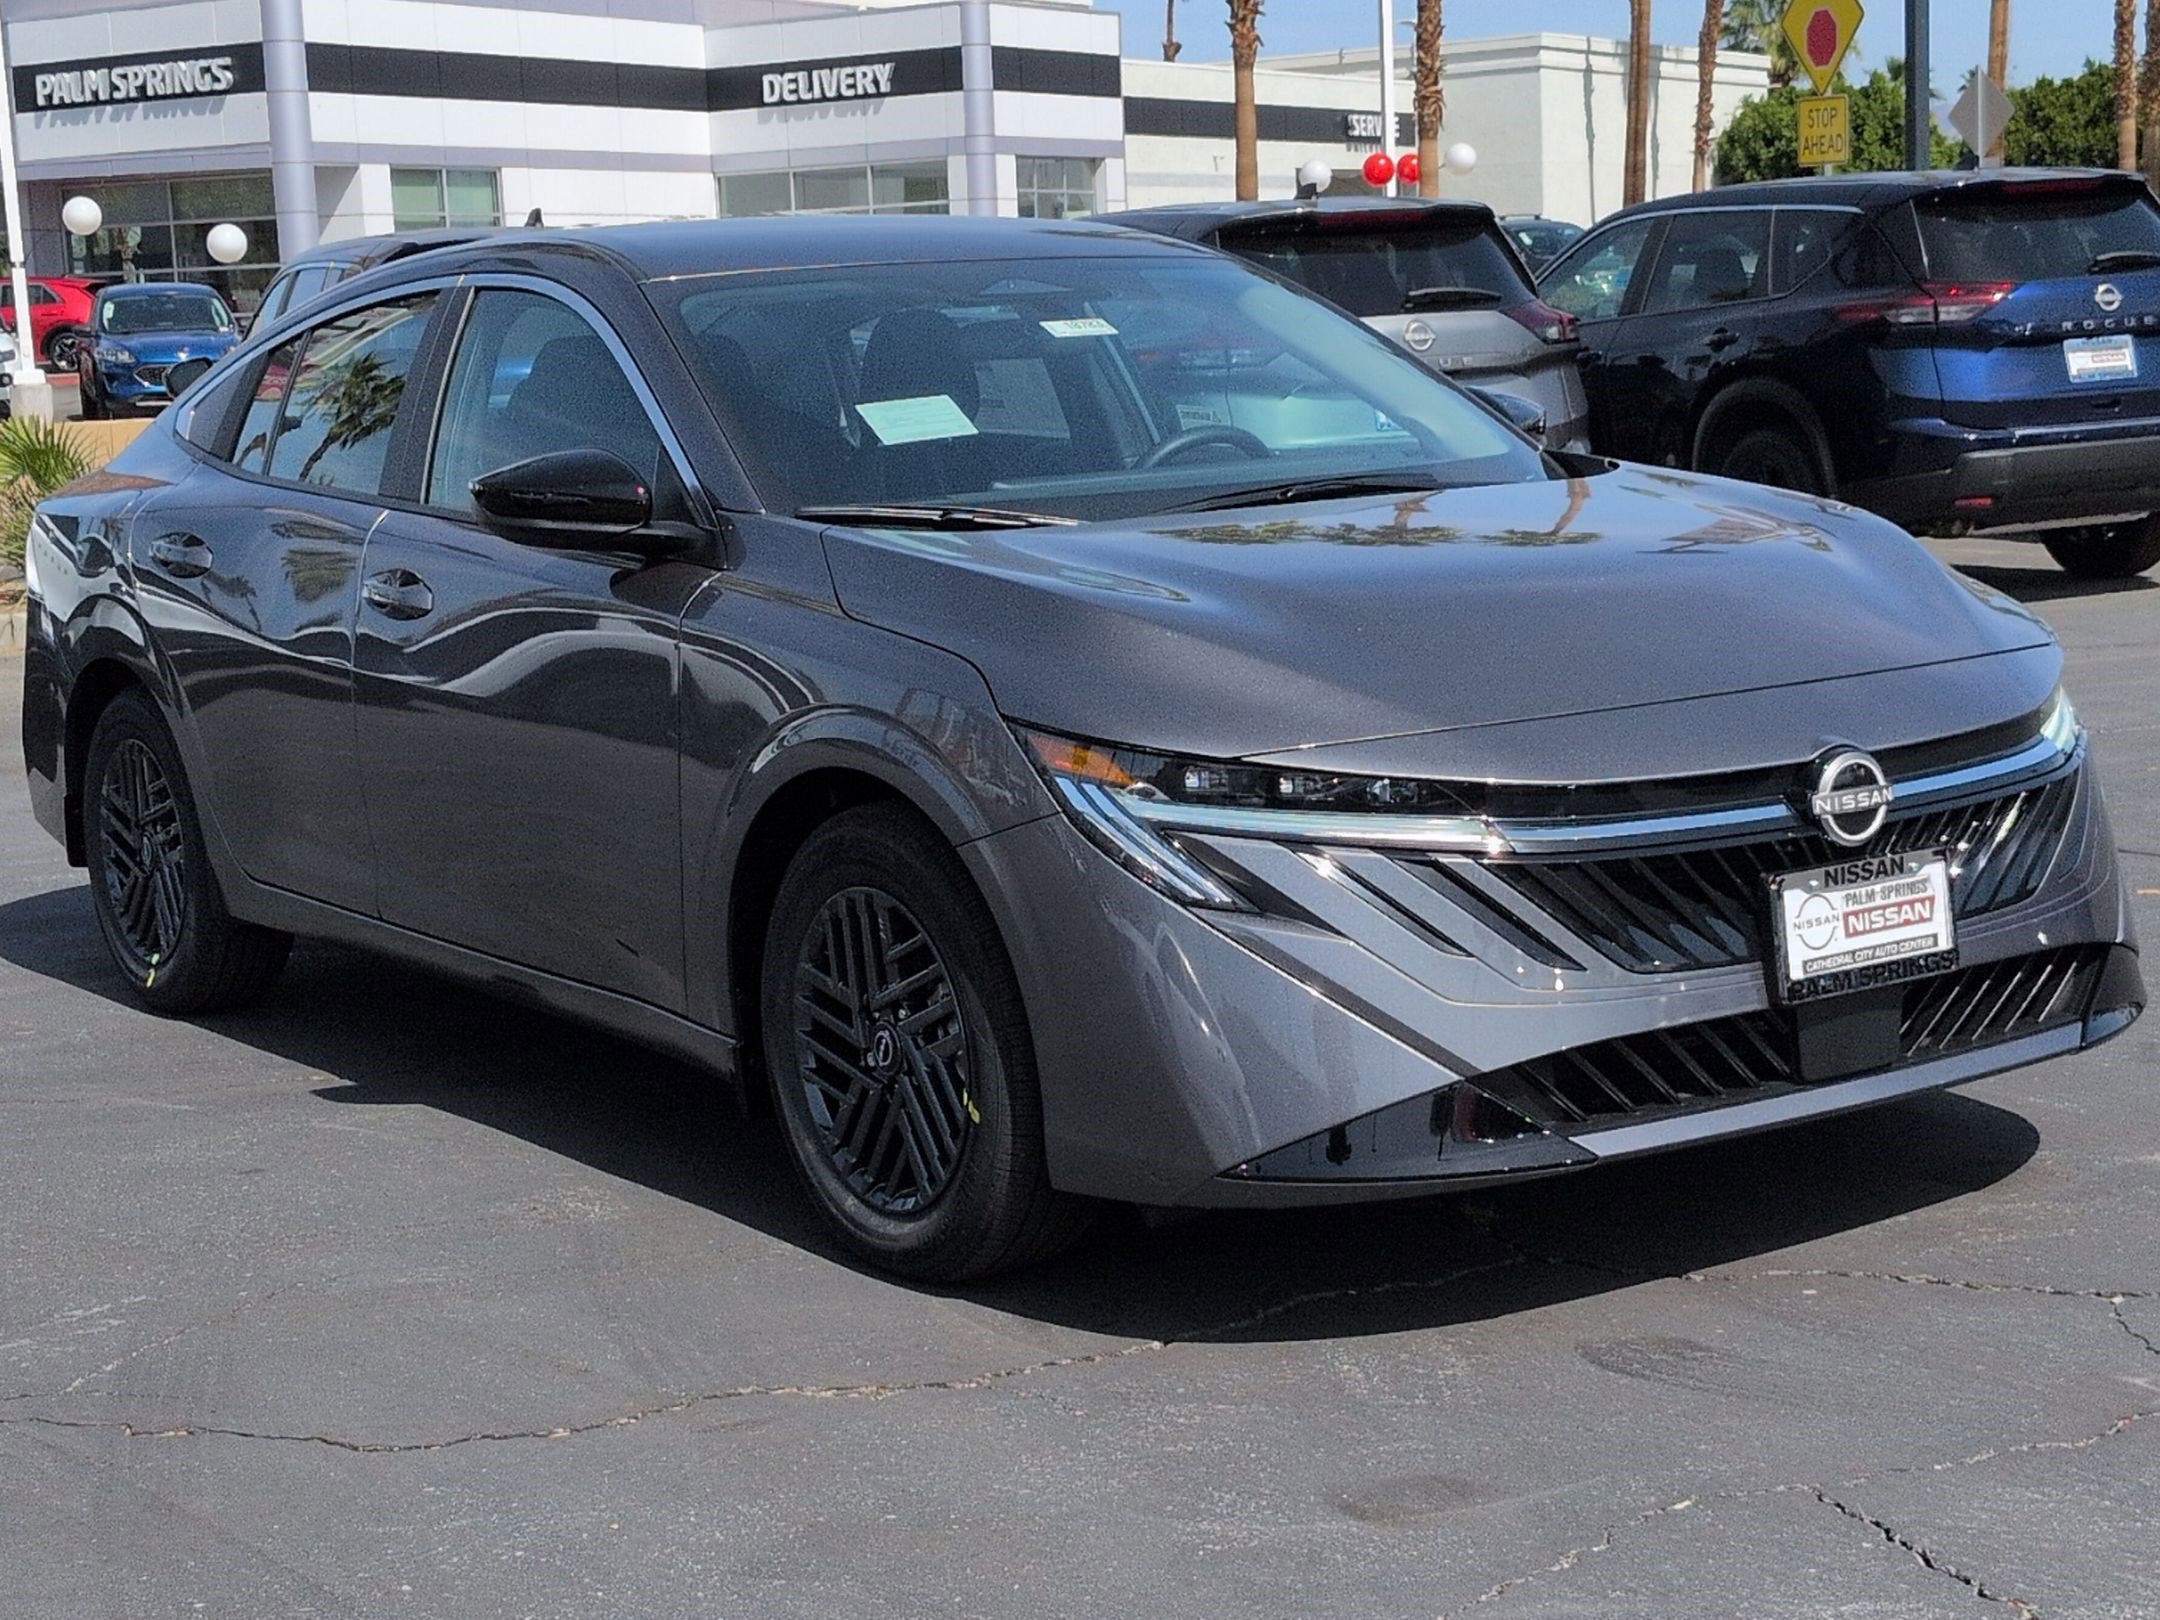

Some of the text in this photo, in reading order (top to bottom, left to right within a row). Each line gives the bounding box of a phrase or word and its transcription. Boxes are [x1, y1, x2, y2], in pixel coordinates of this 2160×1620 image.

[35, 56, 234, 107] PALM SPRINGS
[761, 62, 895, 104] DELIVERY
[1807, 106, 1838, 129] STOP
[1802, 133, 1844, 156] AHEAD
[2061, 315, 2156, 332] ROGUE
[1815, 786, 1894, 812] NISSAN
[1823, 856, 1905, 888] NISSAN
[1845, 880, 1928, 907] PALM SPRINGS
[1793, 913, 1840, 932] NISSAN
[1847, 900, 1931, 933] NISSAN
[1805, 936, 1934, 973] CATHEDRAL CITY AUTO CENTER
[1861, 952, 1955, 986] SPRINGS
